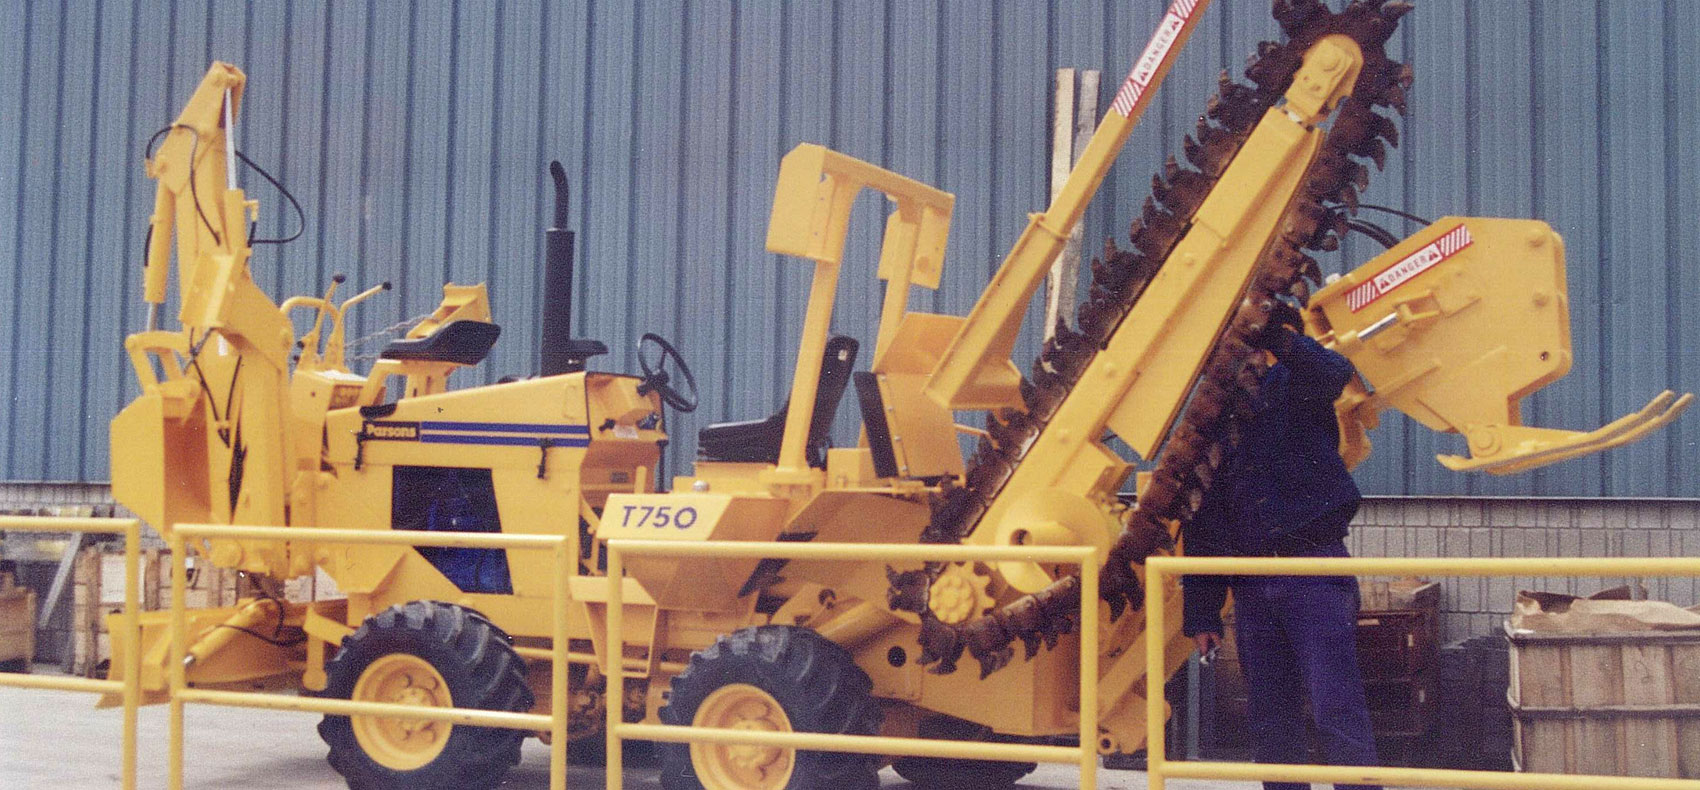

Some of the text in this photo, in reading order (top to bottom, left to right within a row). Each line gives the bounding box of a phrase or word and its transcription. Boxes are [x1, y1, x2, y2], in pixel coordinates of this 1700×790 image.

[1143, 29, 1172, 71] DANGER
[1389, 255, 1428, 282] DANGER
[366, 423, 416, 438] Parsons
[622, 505, 698, 530] T750
